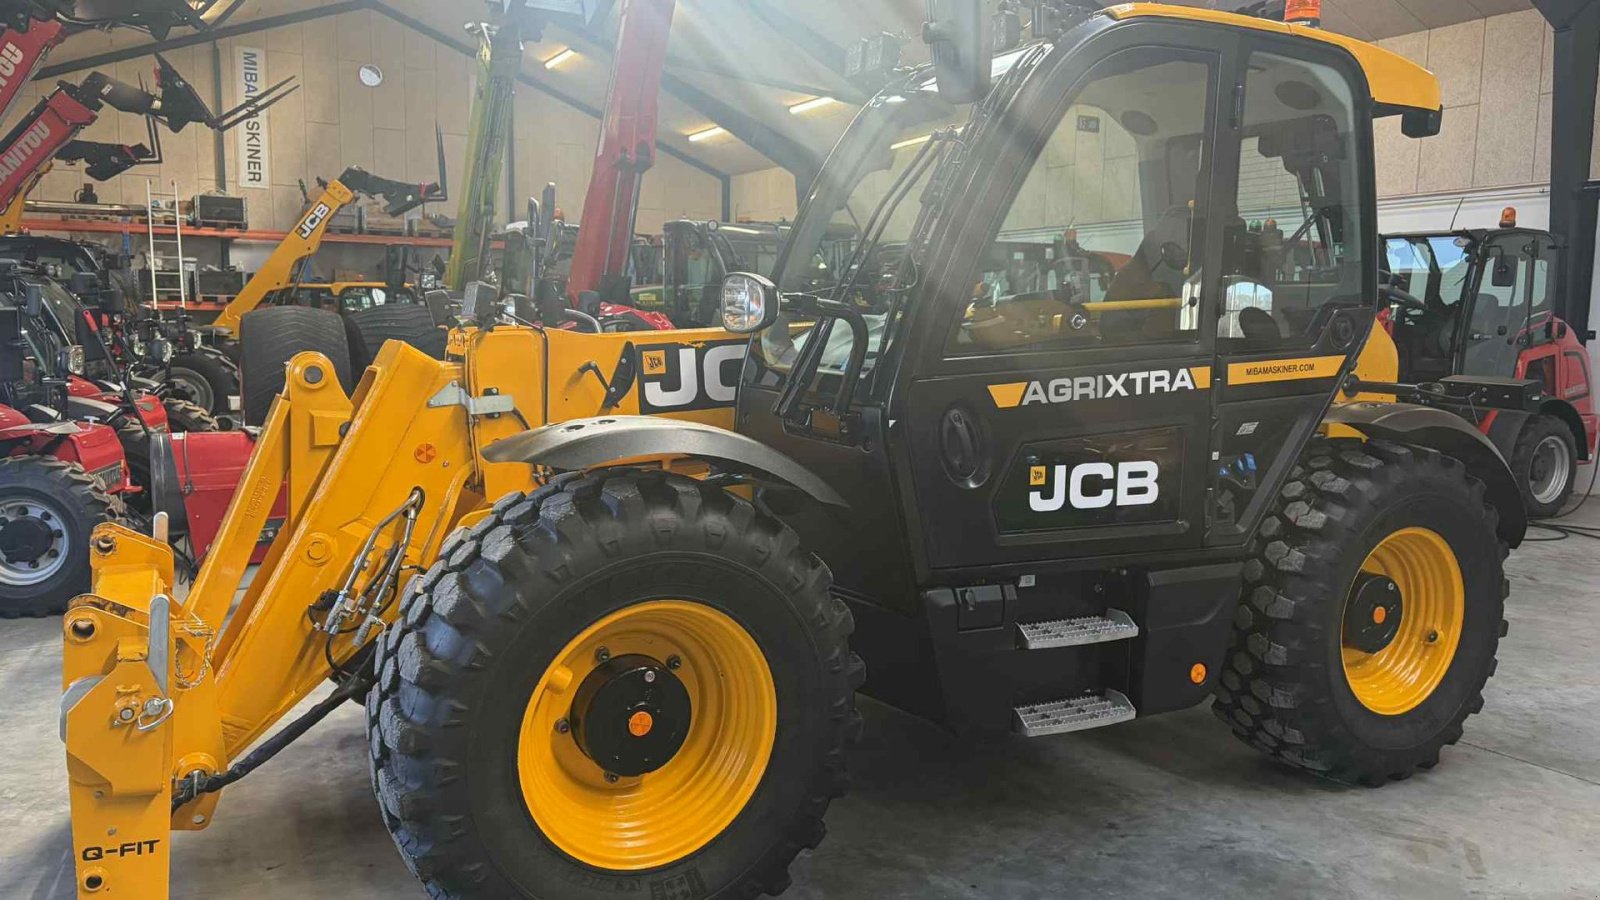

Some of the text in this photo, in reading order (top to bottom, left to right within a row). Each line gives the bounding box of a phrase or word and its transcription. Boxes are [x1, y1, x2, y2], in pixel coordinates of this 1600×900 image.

[0, 120, 50, 186] ANITOU
[301, 203, 330, 238] JCB
[644, 344, 748, 407] JC
[1021, 368, 1194, 406] AGRIXTRA
[1246, 363, 1315, 376] MIBAMASKINER.COM
[1029, 461, 1159, 512] JCB
[82, 839, 161, 861] Q-FIT
